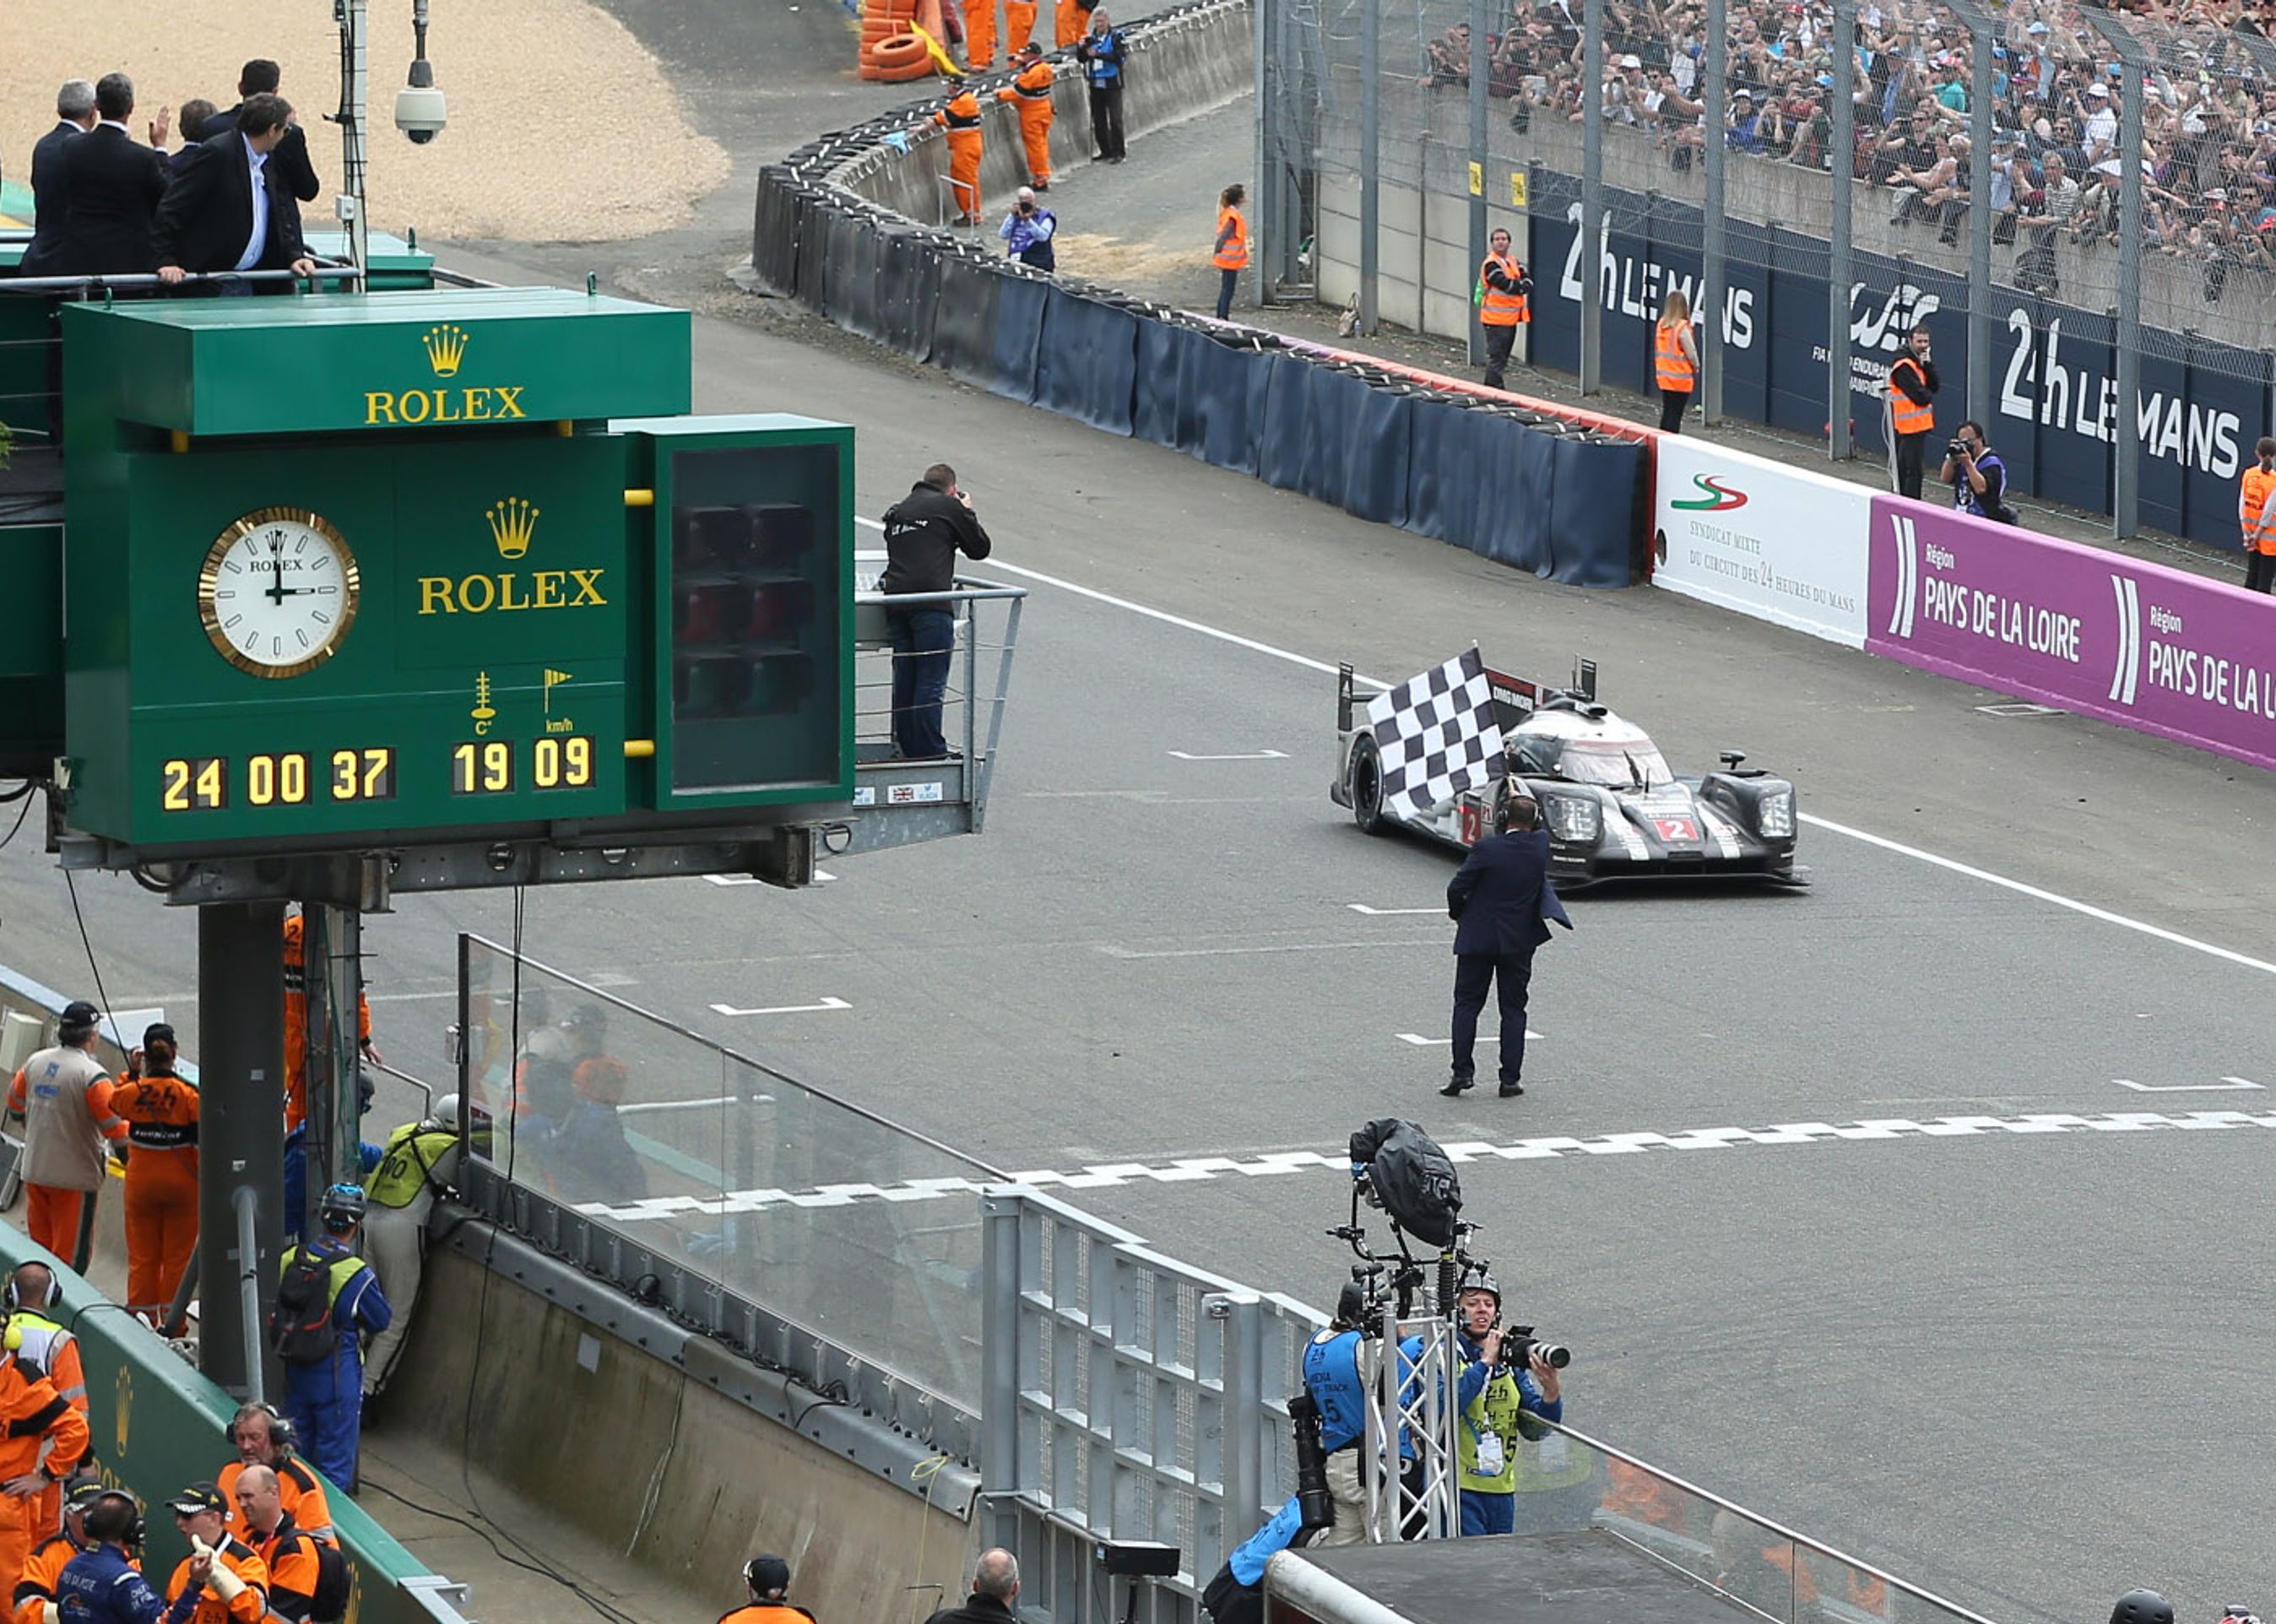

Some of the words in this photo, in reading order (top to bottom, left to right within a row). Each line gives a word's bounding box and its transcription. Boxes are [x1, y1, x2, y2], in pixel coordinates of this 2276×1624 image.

[1622, 257, 1661, 322] LE
[365, 386, 526, 424] ROLEX
[2076, 371, 2117, 443] LE
[2138, 389, 2240, 479] MANS
[1690, 520, 1731, 546] SYNDICAT
[1733, 534, 1761, 555] MIXTE
[1926, 543, 1954, 571] Région
[251, 559, 303, 572] ROLEX
[1690, 549, 1702, 566] DU
[1704, 554, 1739, 578] CIRCUIT
[1742, 567, 1758, 584] DES
[1760, 561, 1773, 588] 24
[1776, 576, 1811, 600] HEURES
[1813, 587, 1826, 604] DU
[1829, 593, 1856, 613] MANS
[418, 569, 607, 614] ROLEX
[1924, 577, 1969, 629] PAYS
[1972, 591, 1997, 638] DE
[2001, 598, 2024, 647] LA
[2028, 605, 2081, 663] LOIRE
[2150, 605, 2181, 634] Région
[2149, 640, 2197, 696] PAYS
[2203, 655, 2229, 706] DE
[2234, 663, 2258, 715] LA
[546, 717, 573, 733] km/h
[164, 759, 220, 809] 24
[249, 753, 305, 804] 00
[333, 749, 388, 799] 37
[454, 742, 508, 792] 19
[535, 737, 589, 787] 09
[1467, 813, 1476, 842] 2
[1668, 820, 1689, 839] 2
